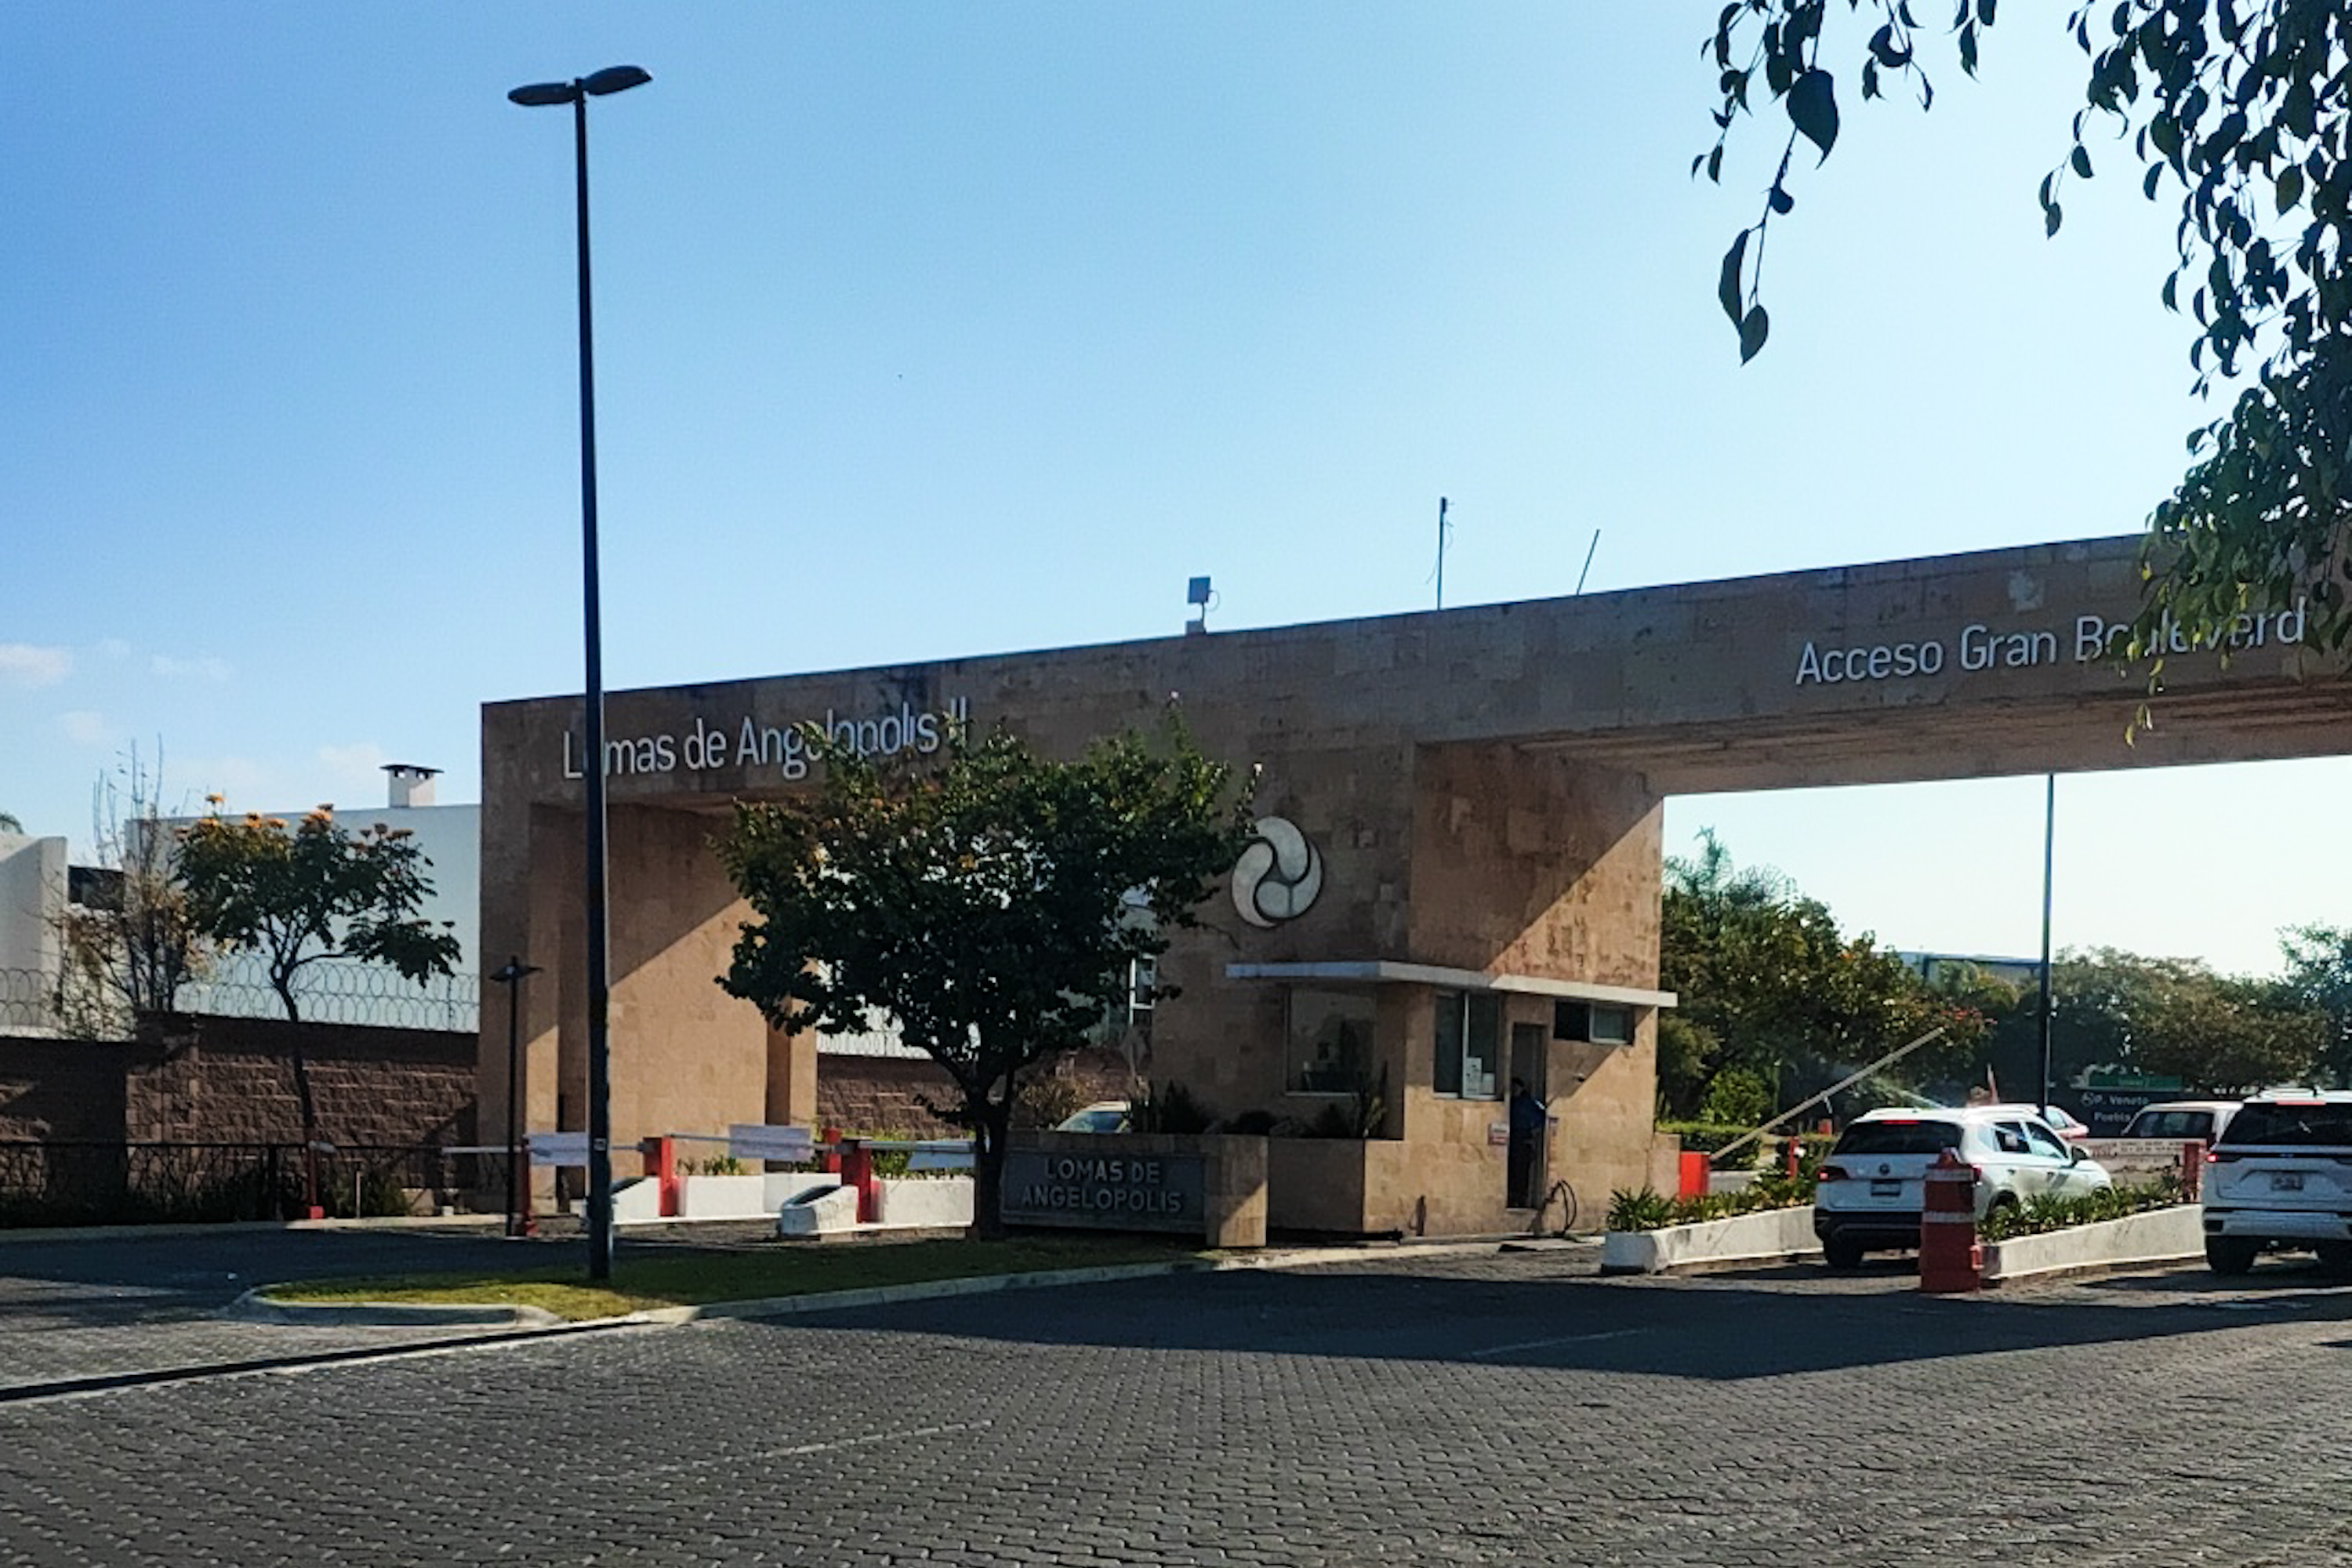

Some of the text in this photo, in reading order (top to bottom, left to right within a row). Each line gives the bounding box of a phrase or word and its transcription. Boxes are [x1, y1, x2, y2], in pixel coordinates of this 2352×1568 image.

[1795, 641, 1944, 685] Acceso
[1960, 624, 2056, 670] Gran
[564, 731, 677, 779] Lmas
[684, 717, 727, 770] de
[1045, 1158, 1161, 1184] LOMAS DE
[1022, 1185, 1182, 1214] ANGELOPOLIS
